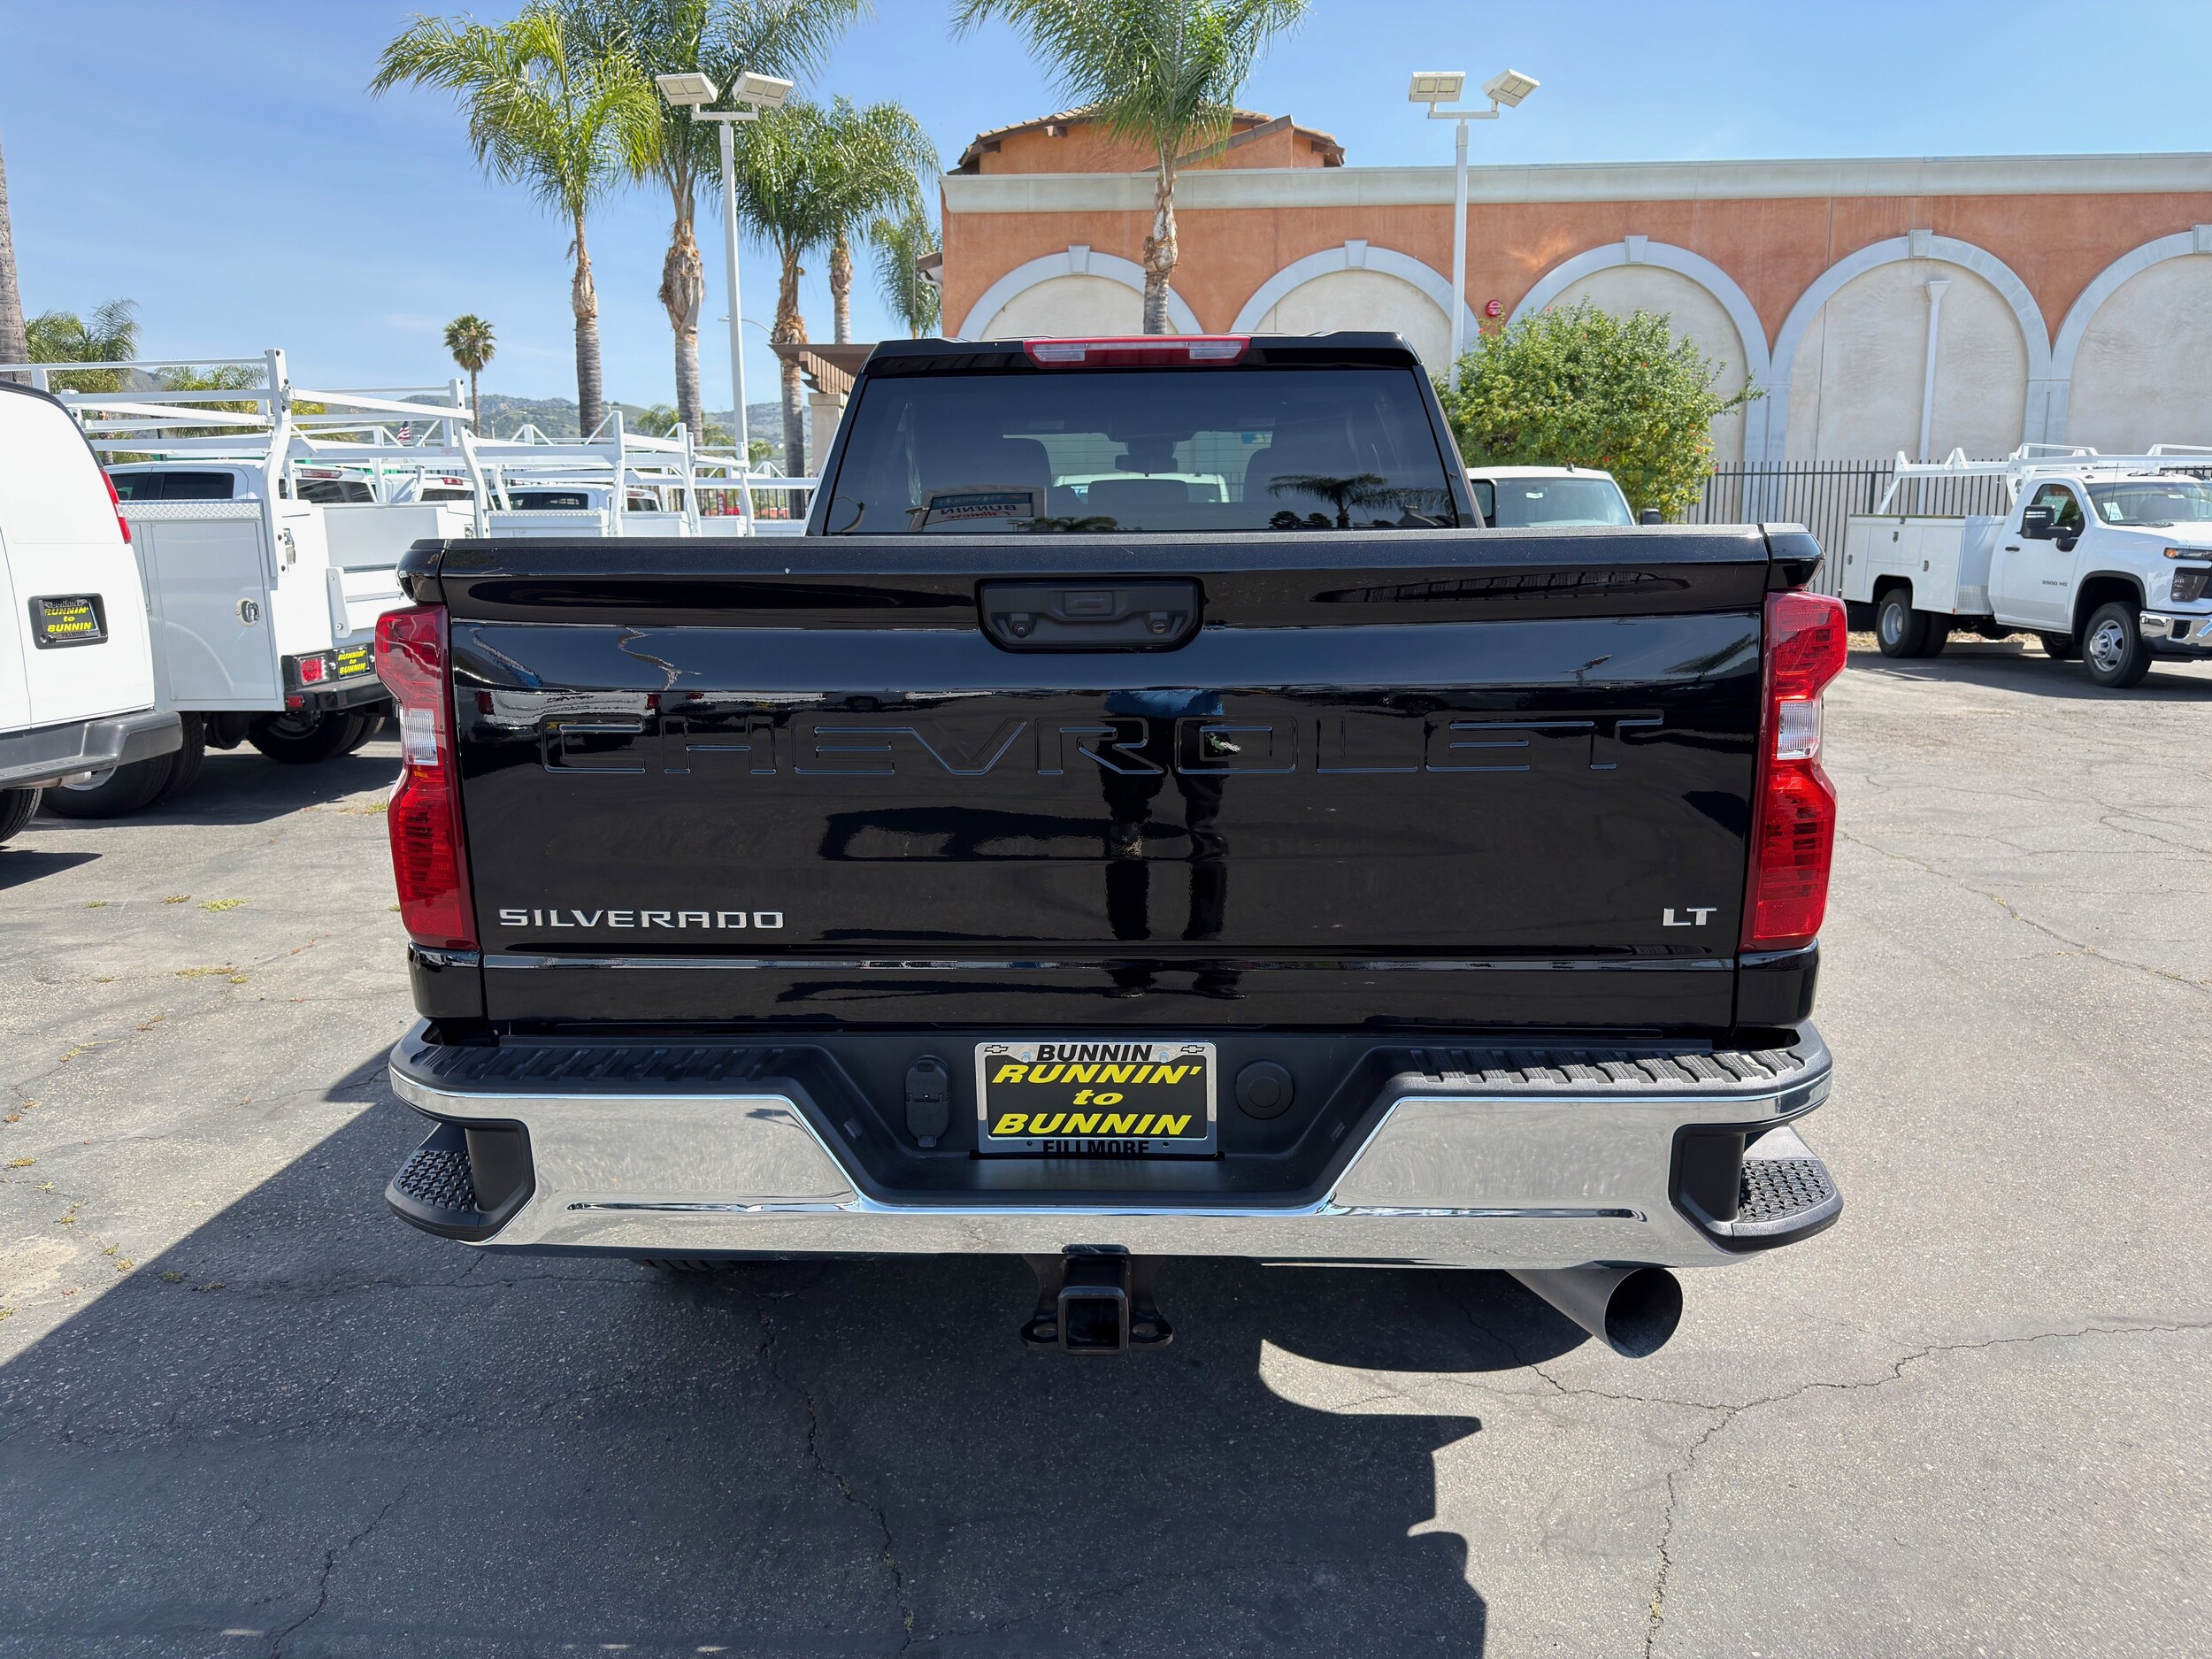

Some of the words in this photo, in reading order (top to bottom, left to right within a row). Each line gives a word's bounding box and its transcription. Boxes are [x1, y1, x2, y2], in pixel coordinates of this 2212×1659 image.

[47, 621, 93, 633] BUNNIN
[538, 710, 1665, 775] CHEVROLET
[498, 909, 784, 929] SILVERADO
[1663, 907, 1717, 926] LT
[1036, 1044, 1152, 1062] BUNNIN
[991, 1064, 1202, 1084] RUNNIN'
[1072, 1089, 1124, 1106] to
[991, 1113, 1193, 1135] BUNNIN
[1042, 1140, 1149, 1153] FILLMORE
